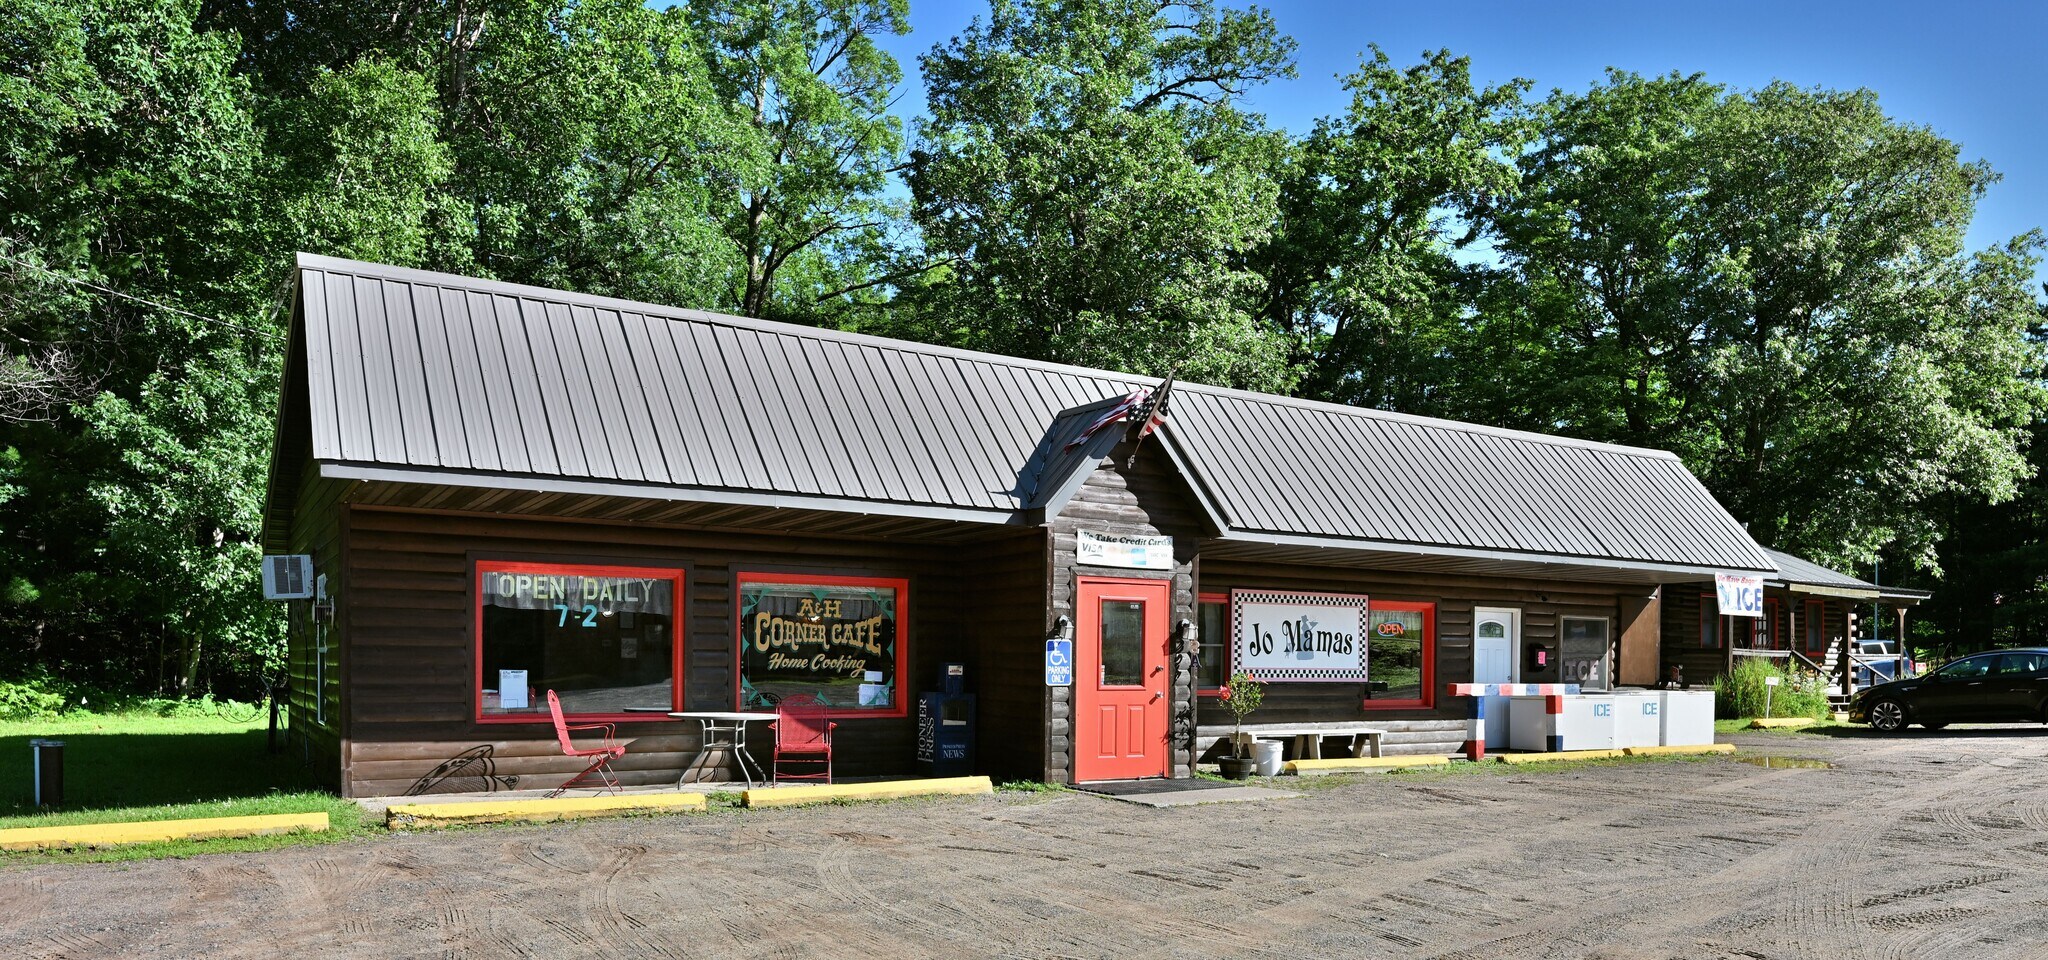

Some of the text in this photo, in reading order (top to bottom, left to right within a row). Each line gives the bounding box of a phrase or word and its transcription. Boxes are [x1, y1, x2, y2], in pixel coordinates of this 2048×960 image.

[1082, 543, 1103, 553] VISA
[1095, 533, 1117, 543] Take
[1119, 536, 1147, 546] Credit
[500, 575, 656, 602] OPEN DAILY
[1736, 587, 1762, 611] ICE
[554, 604, 597, 627] 7-2
[797, 598, 842, 618] A&H
[755, 610, 882, 656] CORNER CAFE
[1250, 620, 1353, 657] Jo Mamas
[1378, 623, 1404, 635] OPEN
[768, 652, 867, 678] Home Cooking
[1048, 665, 1070, 675] PARKING
[1564, 659, 1599, 681] ICE
[1051, 674, 1066, 683] ONLY
[1594, 703, 1610, 717] ICE
[1642, 702, 1657, 715] ICE
[918, 699, 927, 761] PIONEER
[925, 717, 934, 762] PRESS
[943, 749, 965, 759] NEWS
